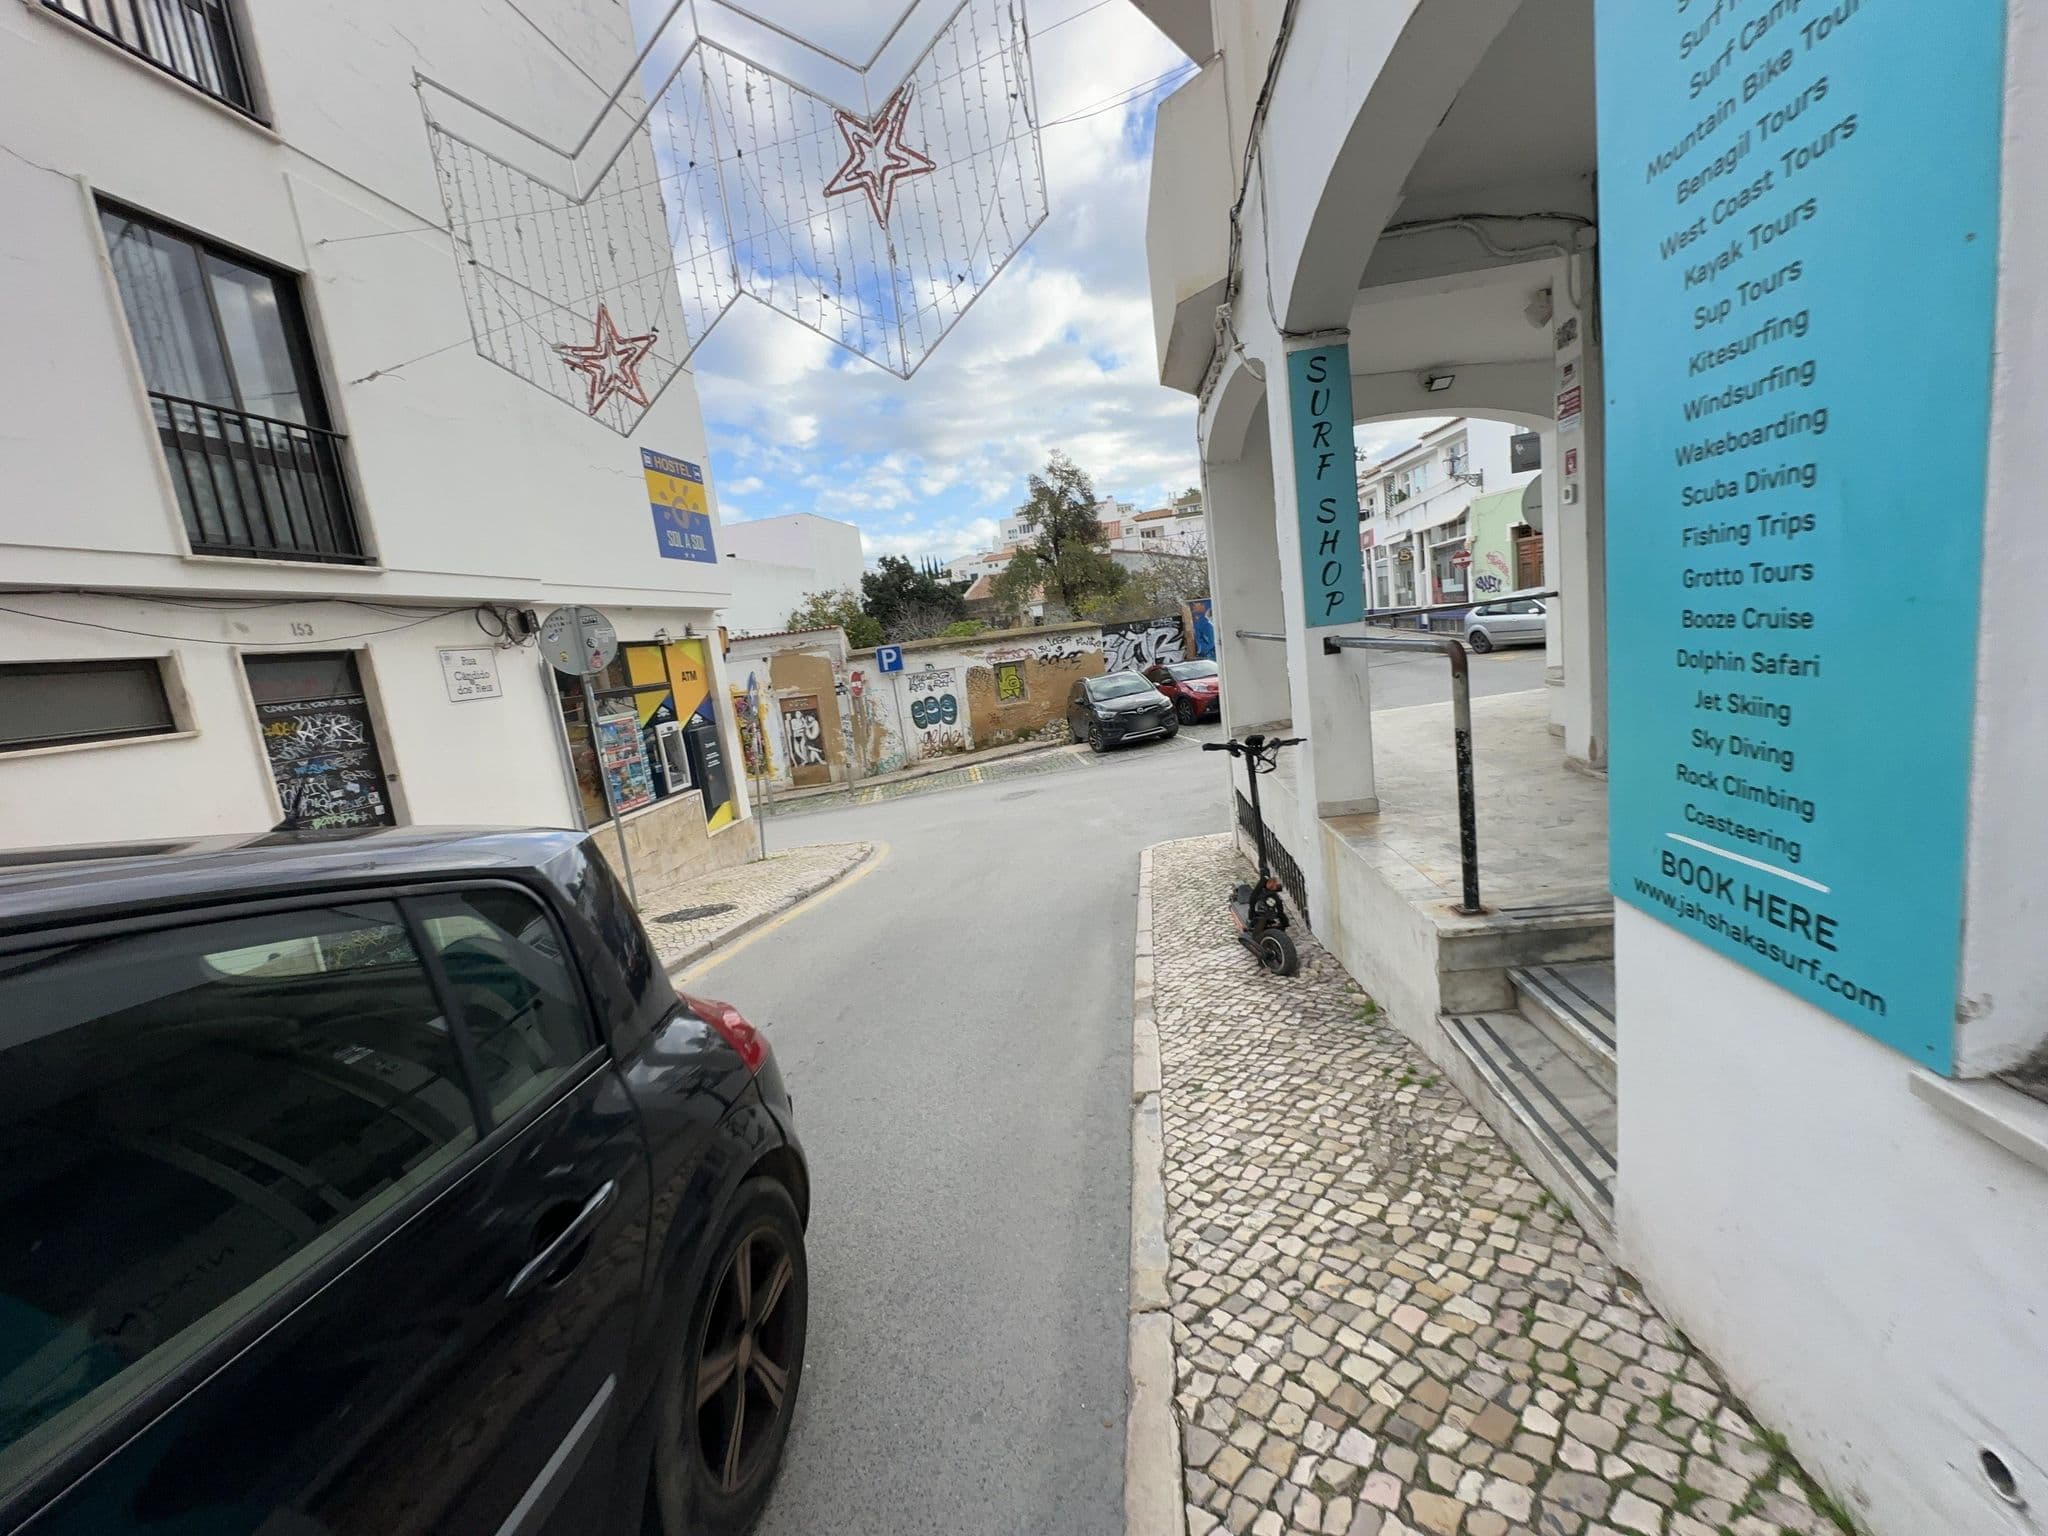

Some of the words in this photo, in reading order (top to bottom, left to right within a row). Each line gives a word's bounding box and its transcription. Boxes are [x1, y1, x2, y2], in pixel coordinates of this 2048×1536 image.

[1689, 38, 1735, 100] Surf
[1646, 98, 1736, 185] Mountain
[1743, 48, 1793, 104] Bike
[1676, 129, 1751, 205] Benagil
[1756, 74, 1829, 142] Tours
[1660, 215, 1709, 260] West
[1711, 168, 1775, 225] Coast
[1780, 113, 1858, 178] Tours
[1684, 239, 1744, 291] Kayak
[1748, 197, 1819, 250] Tours
[1694, 298, 1732, 330] Sup
[1736, 260, 1803, 306] Tours
[1688, 309, 1810, 378] Kitesurfing
[1306, 355, 1335, 481] SURF
[1683, 359, 1816, 422] Windsurfing
[653, 455, 692, 478] HOSTEL
[1675, 407, 1829, 467] Wakeboarding
[1682, 479, 1739, 507] Scuba
[1745, 463, 1818, 495] Diving
[1316, 497, 1345, 618] SHOP
[1682, 522, 1750, 548] Fishing
[1757, 512, 1817, 541] Trips
[1682, 567, 1744, 589] Grotto
[1750, 562, 1815, 584] Tours
[291, 623, 315, 637] 153
[1682, 609, 1737, 629] Booze
[1742, 606, 1815, 630] Cruise
[457, 685, 473, 695] dos
[475, 684, 493, 693] Reis
[461, 656, 477, 666] Rua
[681, 671, 698, 682] ATM
[881, 649, 897, 671] P
[1676, 648, 1746, 674] Dolphin
[1751, 651, 1820, 678] Safari
[1694, 690, 1722, 712] Jet
[1728, 693, 1792, 727] Skiing
[1691, 728, 1725, 756] Sky
[1729, 735, 1794, 773] Diving
[1676, 763, 1719, 791] Rock
[1723, 775, 1815, 823] Climbing
[1684, 803, 1801, 864] Coasteering
[1661, 850, 1735, 905] BOOK
[1743, 883, 1839, 953] HERE
[1634, 877, 1888, 1017] www.jahshakasurf.com
